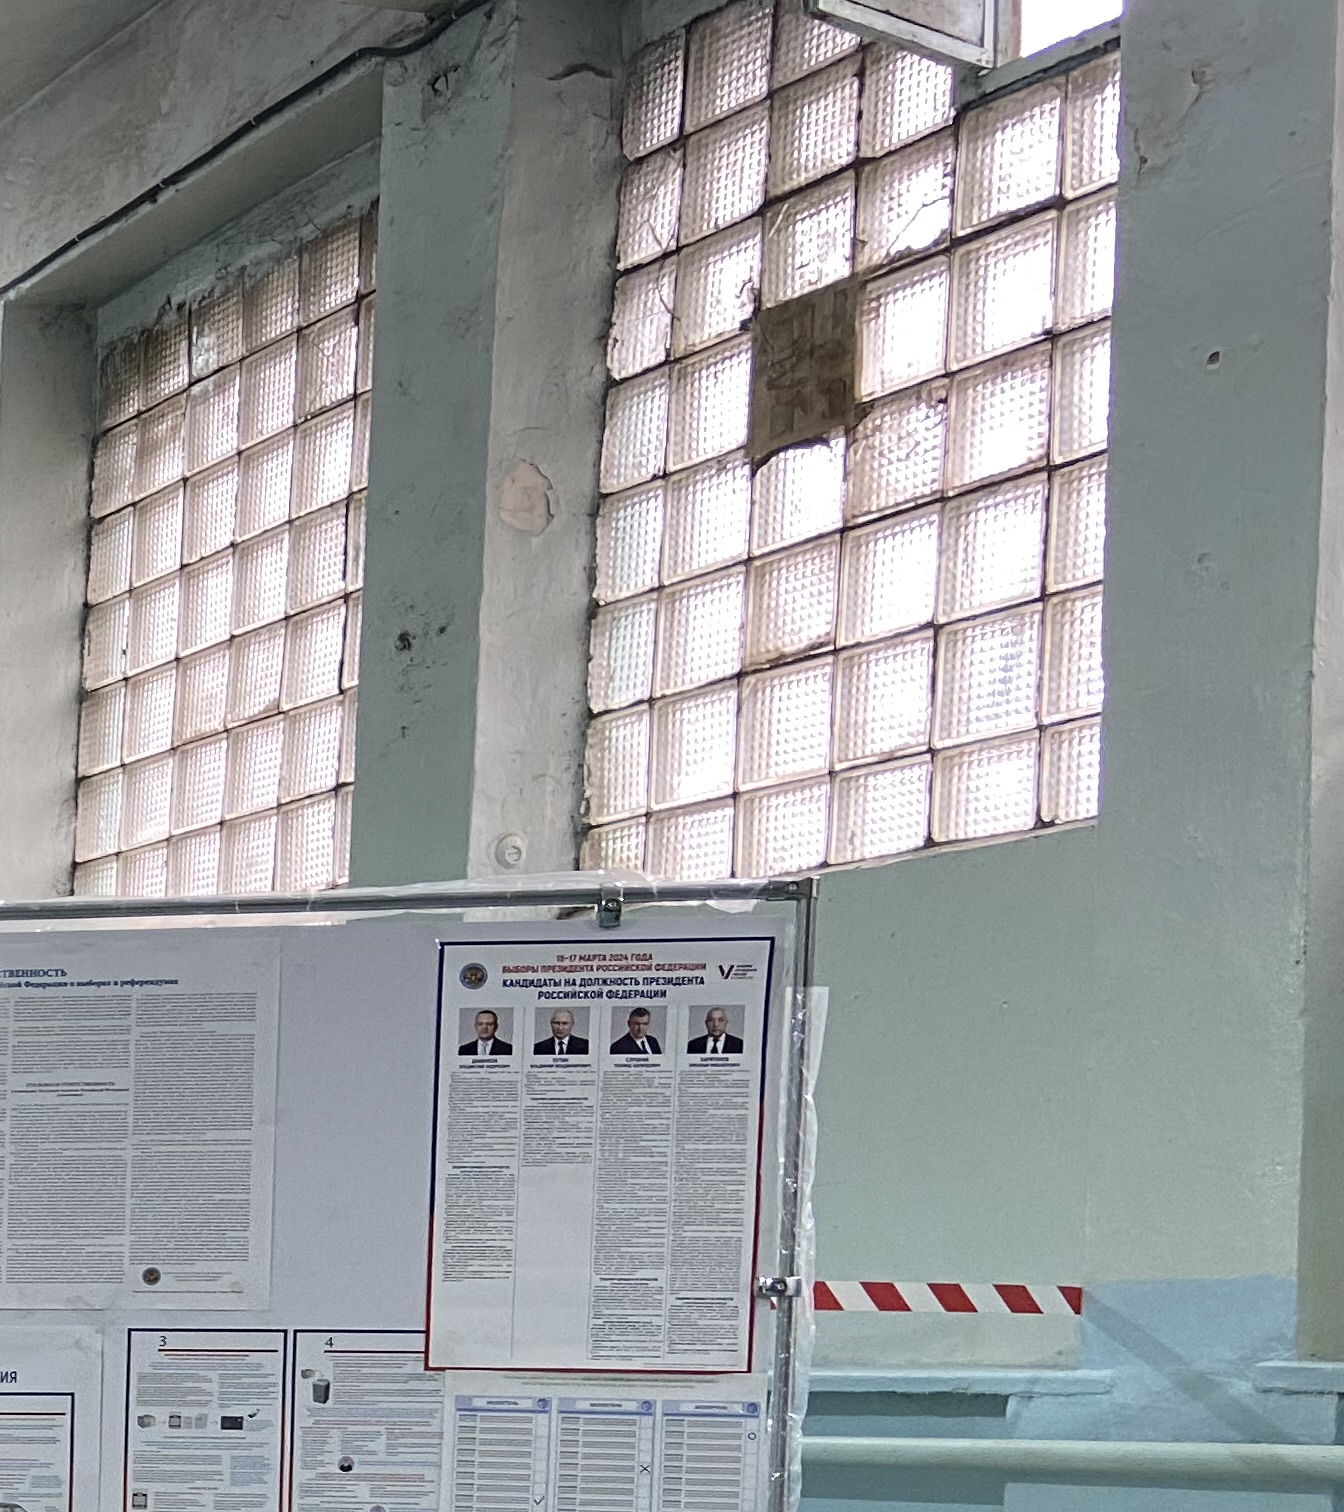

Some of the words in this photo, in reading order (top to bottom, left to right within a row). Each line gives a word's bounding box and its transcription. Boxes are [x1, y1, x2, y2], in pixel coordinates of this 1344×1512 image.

[579, 954, 607, 962] МАРТА
[609, 953, 628, 962] 2024
[630, 953, 653, 962] ГОДА
[502, 965, 539, 974] ВЫБОРЫ
[541, 964, 594, 973] ПРЕЗИДЕНТА
[596, 963, 653, 972] РОССИЙСКОЙ
[654, 962, 707, 972] ФЕДЕРАЦИИ
[502, 977, 562, 988] КАНДИДАТЫ
[564, 977, 577, 987] НА
[578, 976, 640, 987] ДОЛЖНОСТЬ
[642, 976, 705, 987] ПРЕЗИДЕНТА
[537, 988, 604, 1000] РОССИЙСКОЙ
[605, 988, 667, 999] ФЕДЕРАЦИИ
[159, 1336, 168, 1347] 3
[324, 1336, 334, 1348] 4
